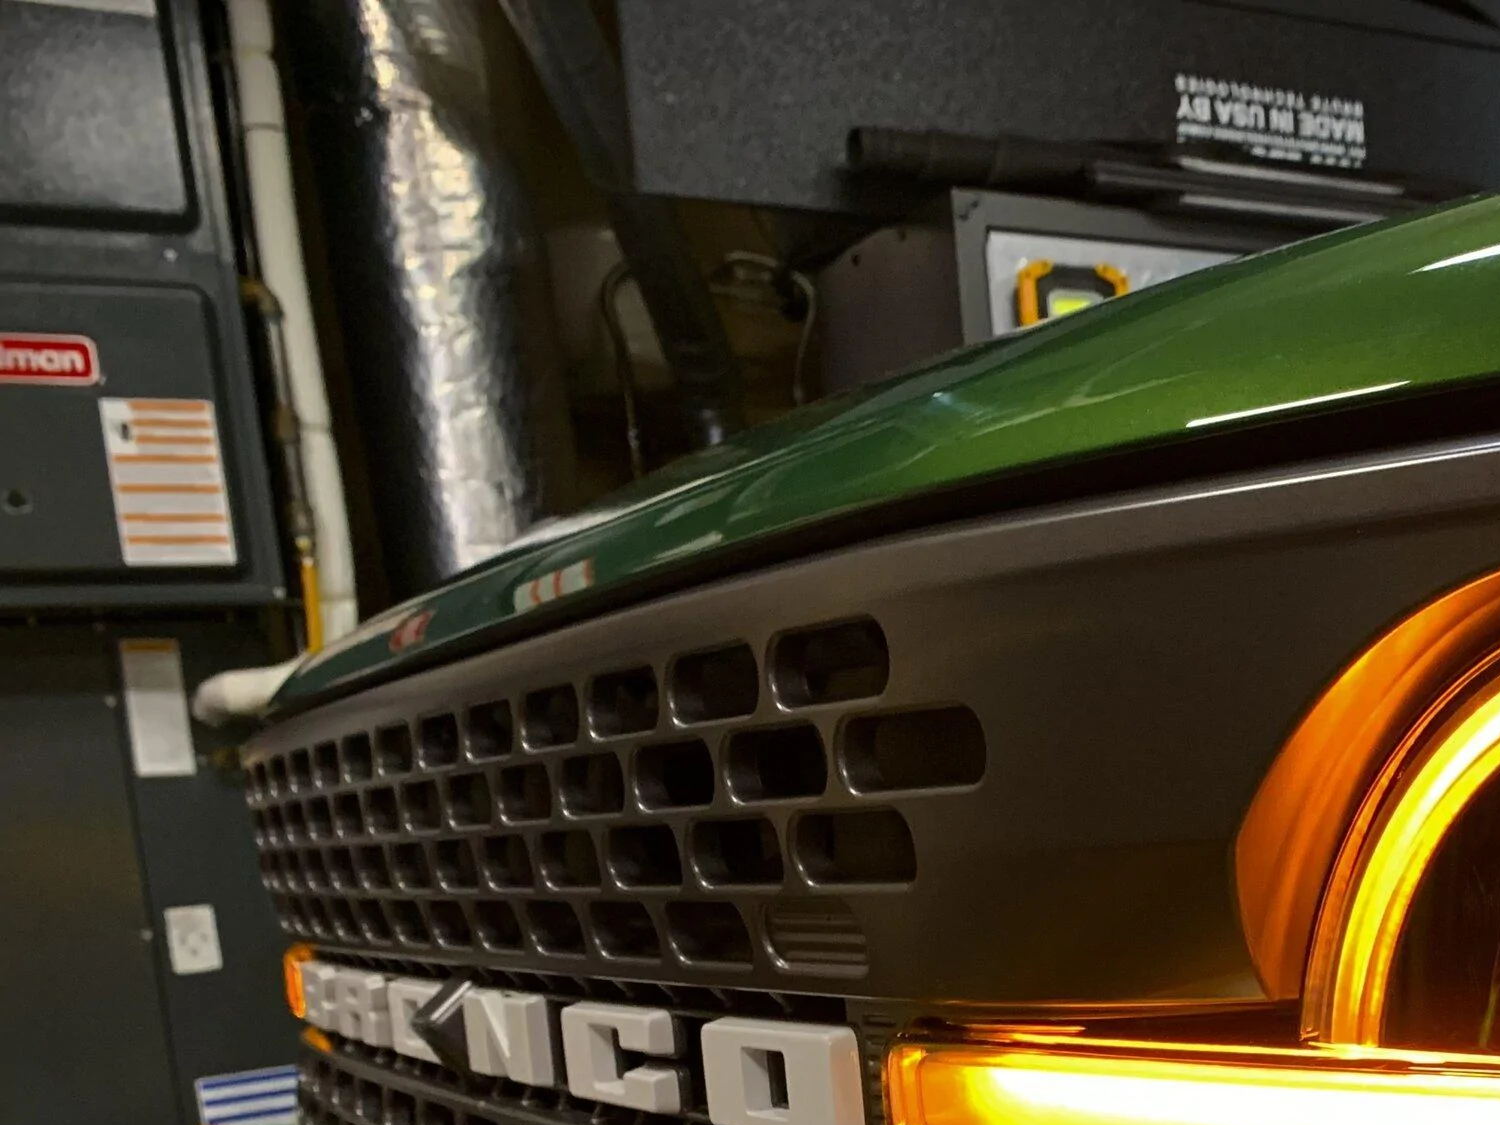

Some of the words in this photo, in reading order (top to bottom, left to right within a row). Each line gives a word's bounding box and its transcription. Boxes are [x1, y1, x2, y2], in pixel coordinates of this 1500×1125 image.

[1176, 93, 1212, 123] BY
[1214, 99, 1266, 131] USA
[1269, 107, 1294, 134] IN
[1298, 111, 1365, 144] MADE
